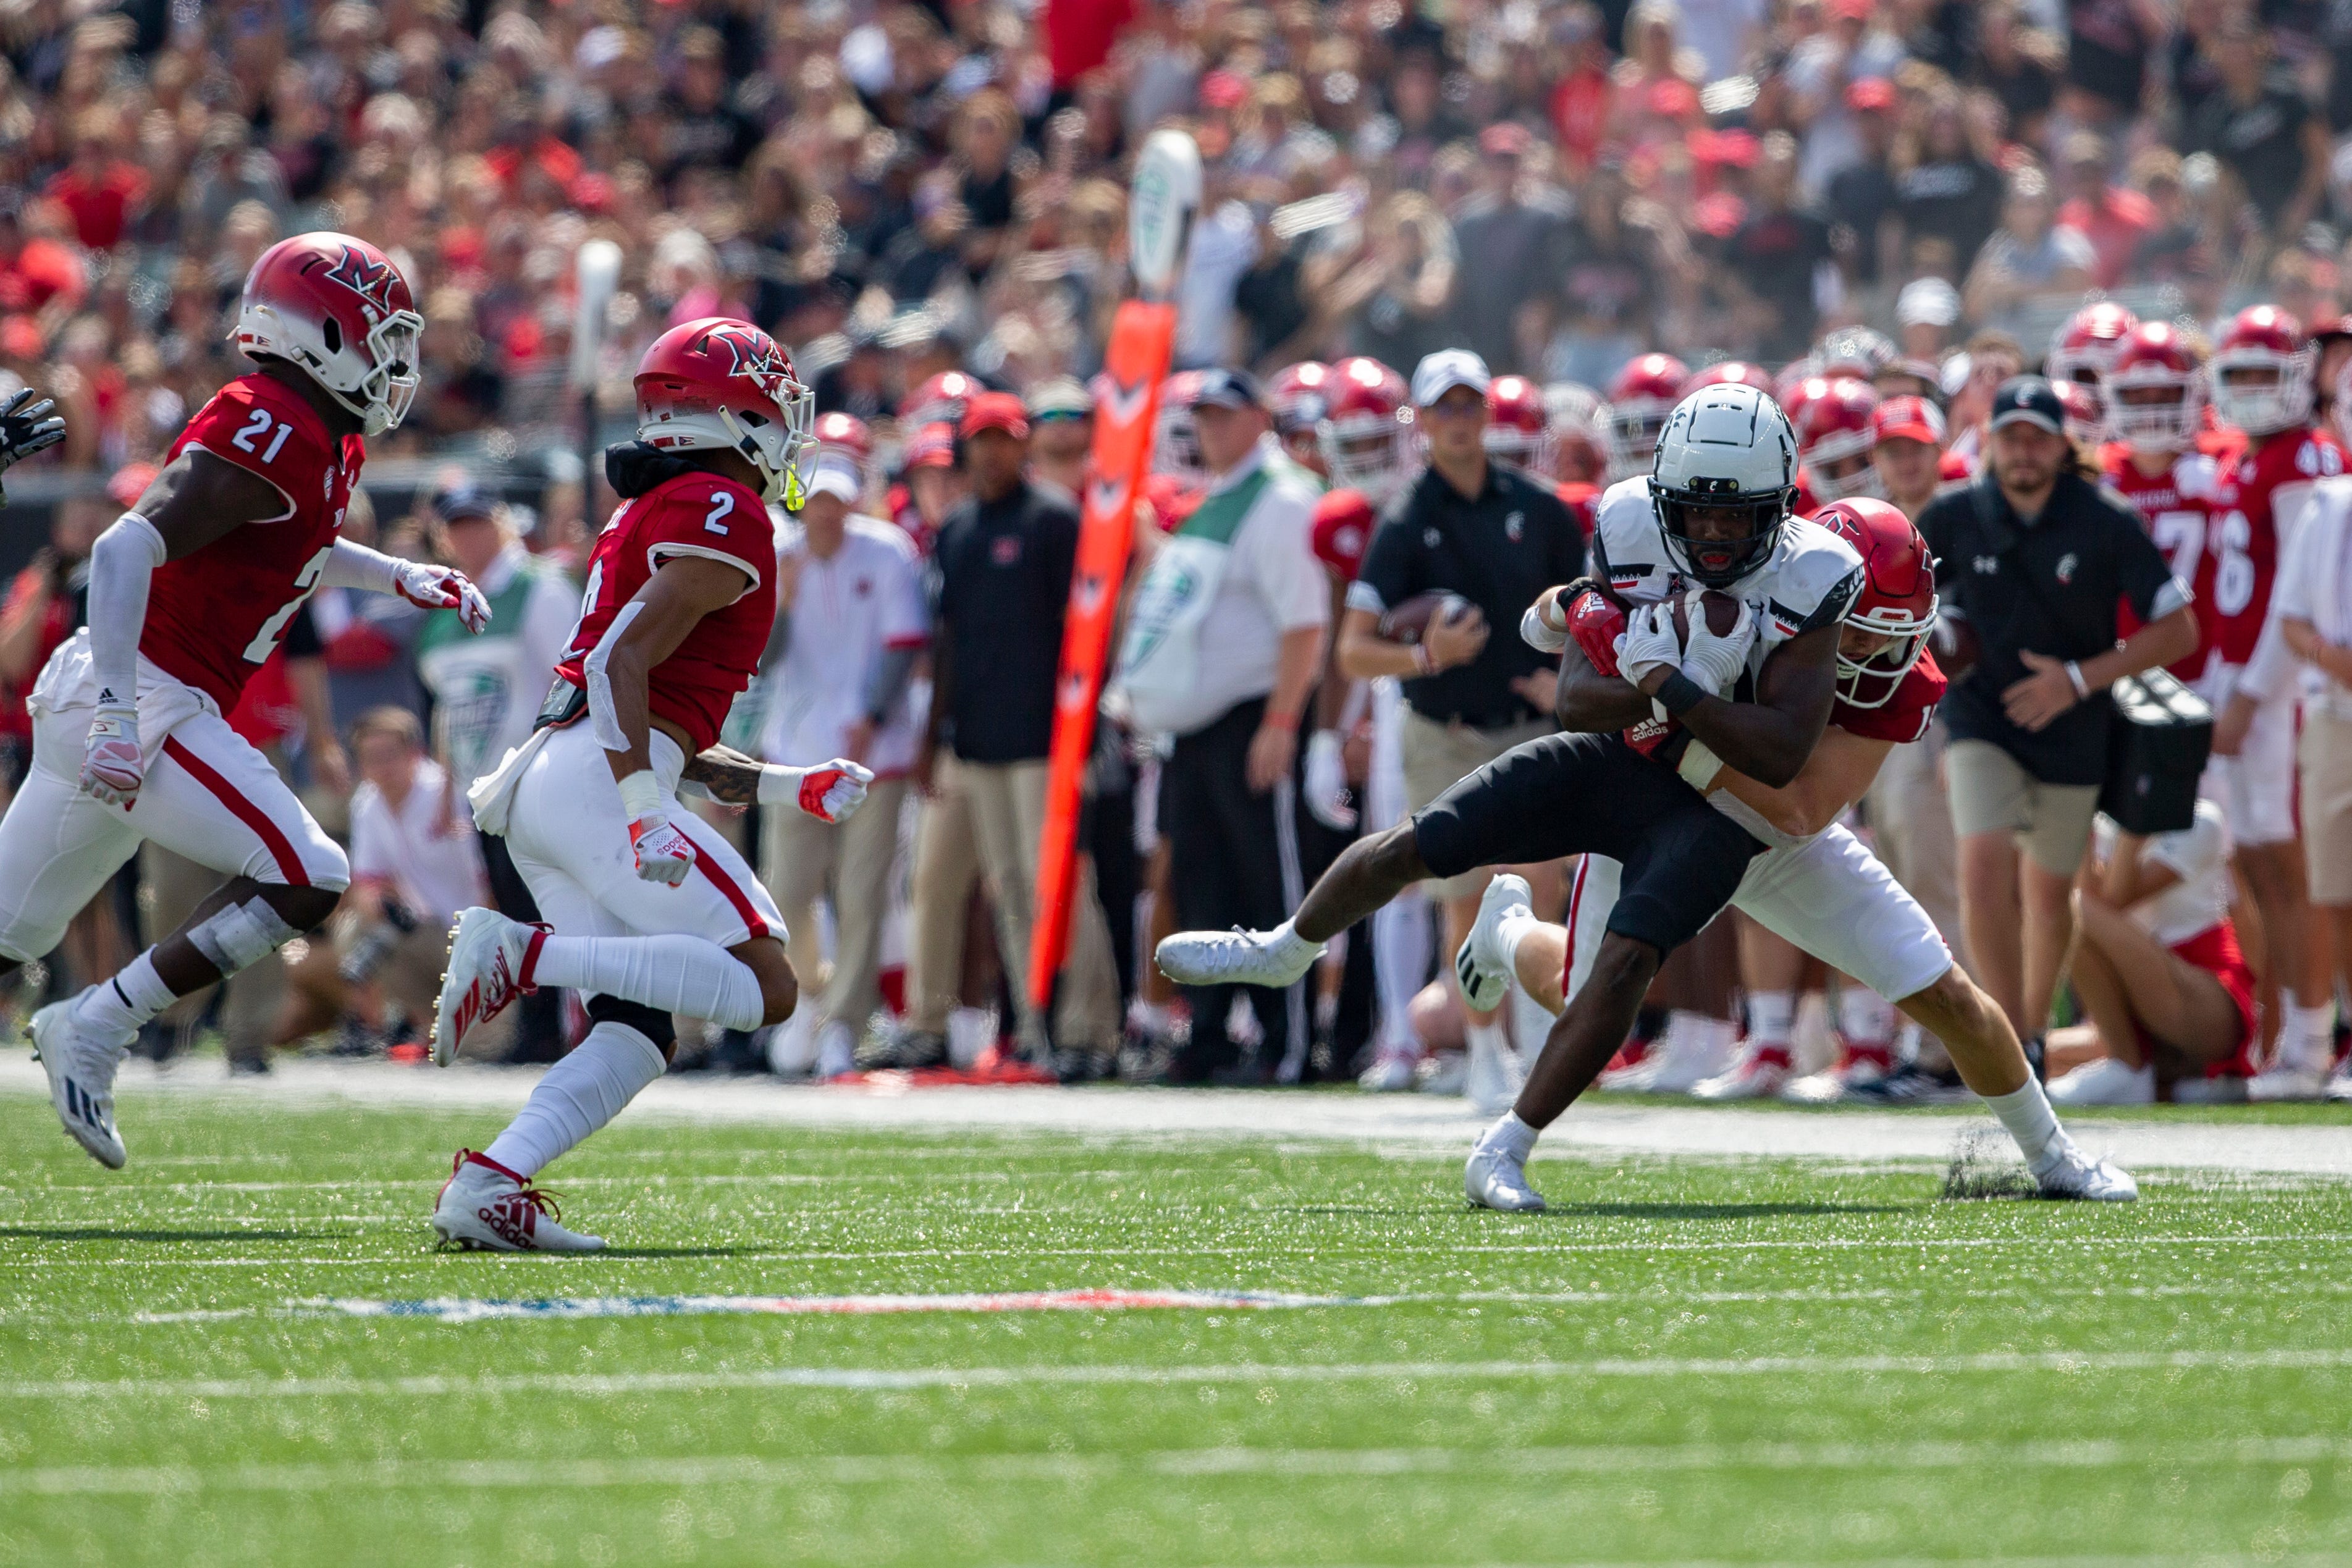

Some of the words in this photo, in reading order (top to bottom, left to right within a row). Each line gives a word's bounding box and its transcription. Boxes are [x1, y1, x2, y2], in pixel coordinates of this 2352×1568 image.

[231, 407, 295, 465] 21
[704, 491, 735, 536] 2
[1632, 726, 1668, 742] adidas
[1910, 704, 1937, 741] 1
